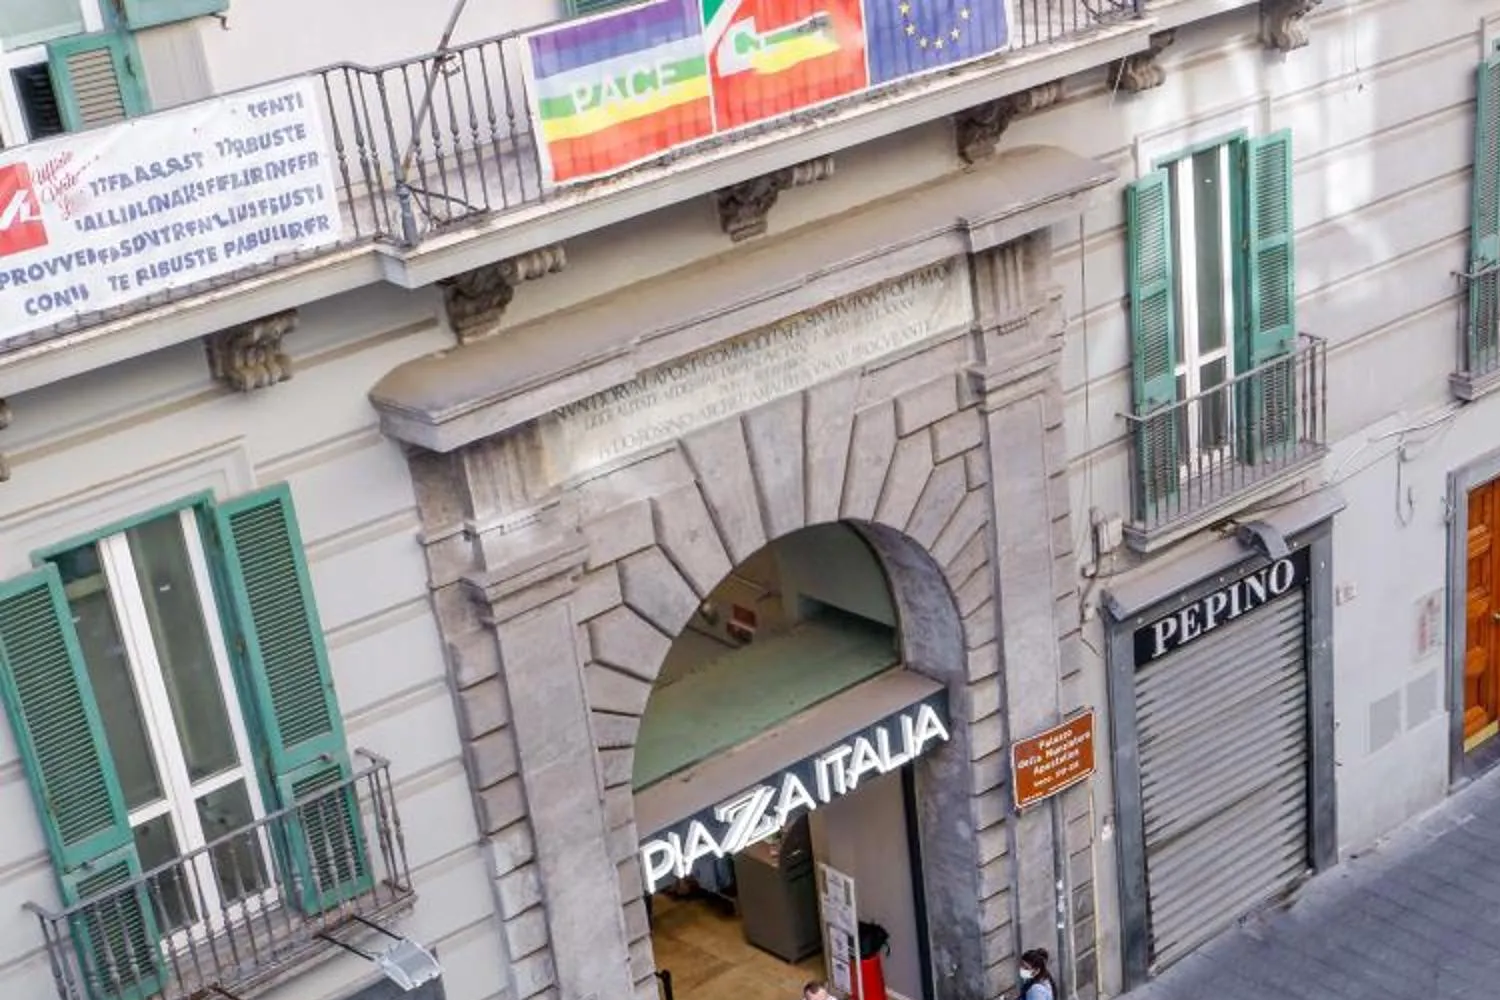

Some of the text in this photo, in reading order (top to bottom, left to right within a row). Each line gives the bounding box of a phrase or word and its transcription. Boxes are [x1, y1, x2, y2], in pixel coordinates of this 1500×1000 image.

[1151, 559, 1295, 658] PEPINO
[639, 703, 949, 895] PIAZZA ITALIA
